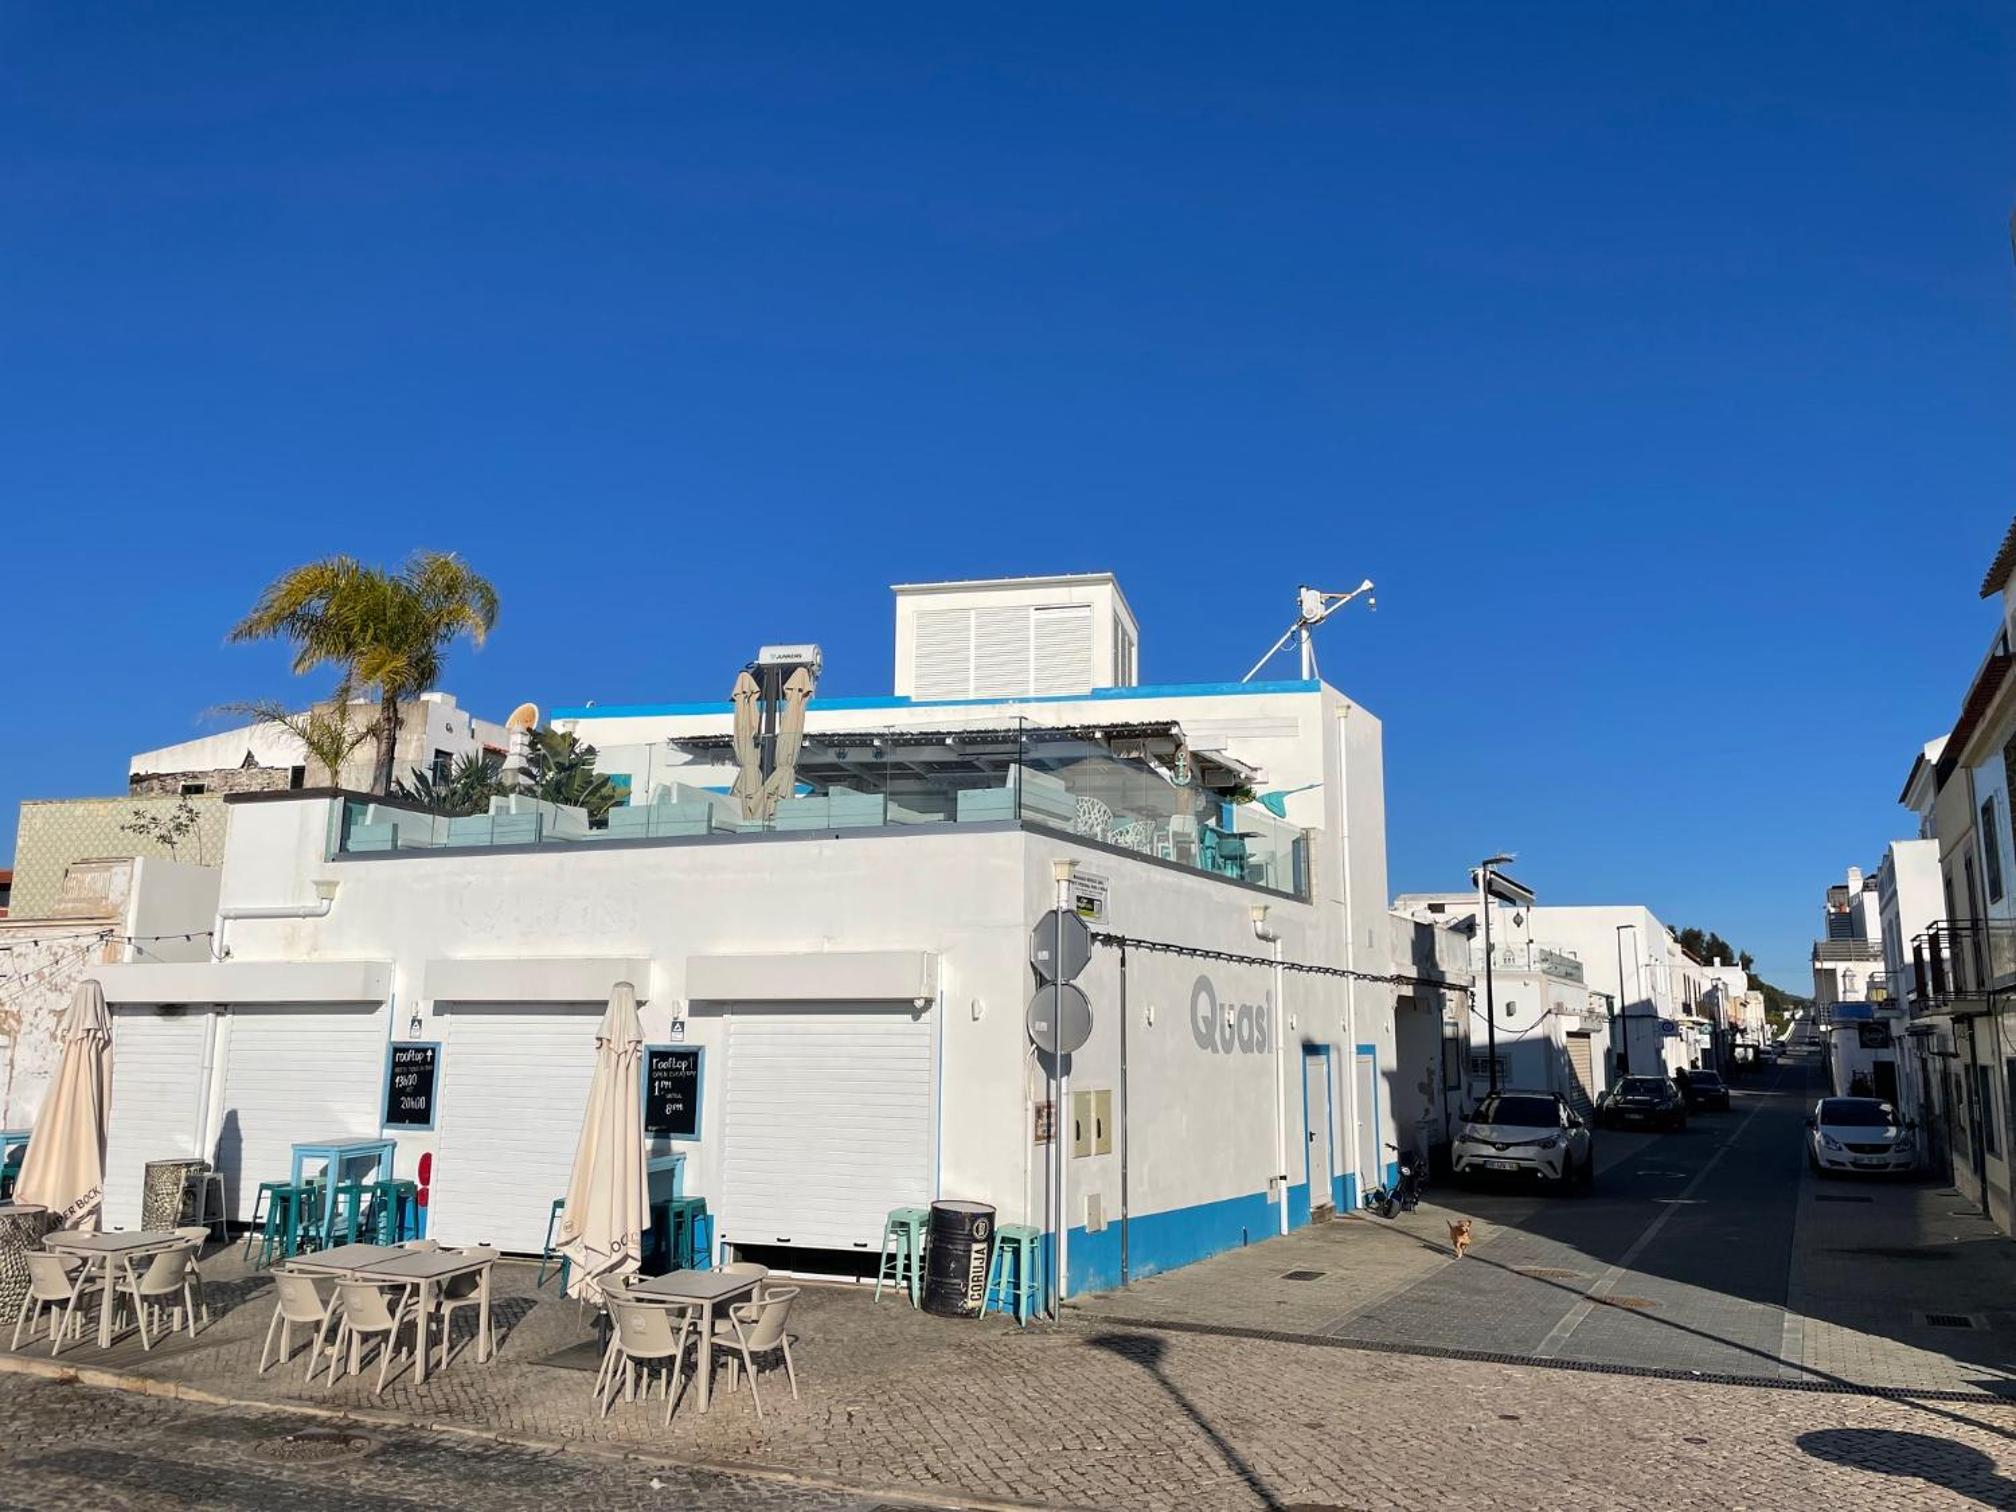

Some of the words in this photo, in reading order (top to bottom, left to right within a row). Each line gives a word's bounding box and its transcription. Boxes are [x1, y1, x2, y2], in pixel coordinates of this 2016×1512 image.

[395, 1049, 425, 1064] rooftop
[75, 1186, 102, 1209] BOCK
[969, 1247, 986, 1302] CORUJA
